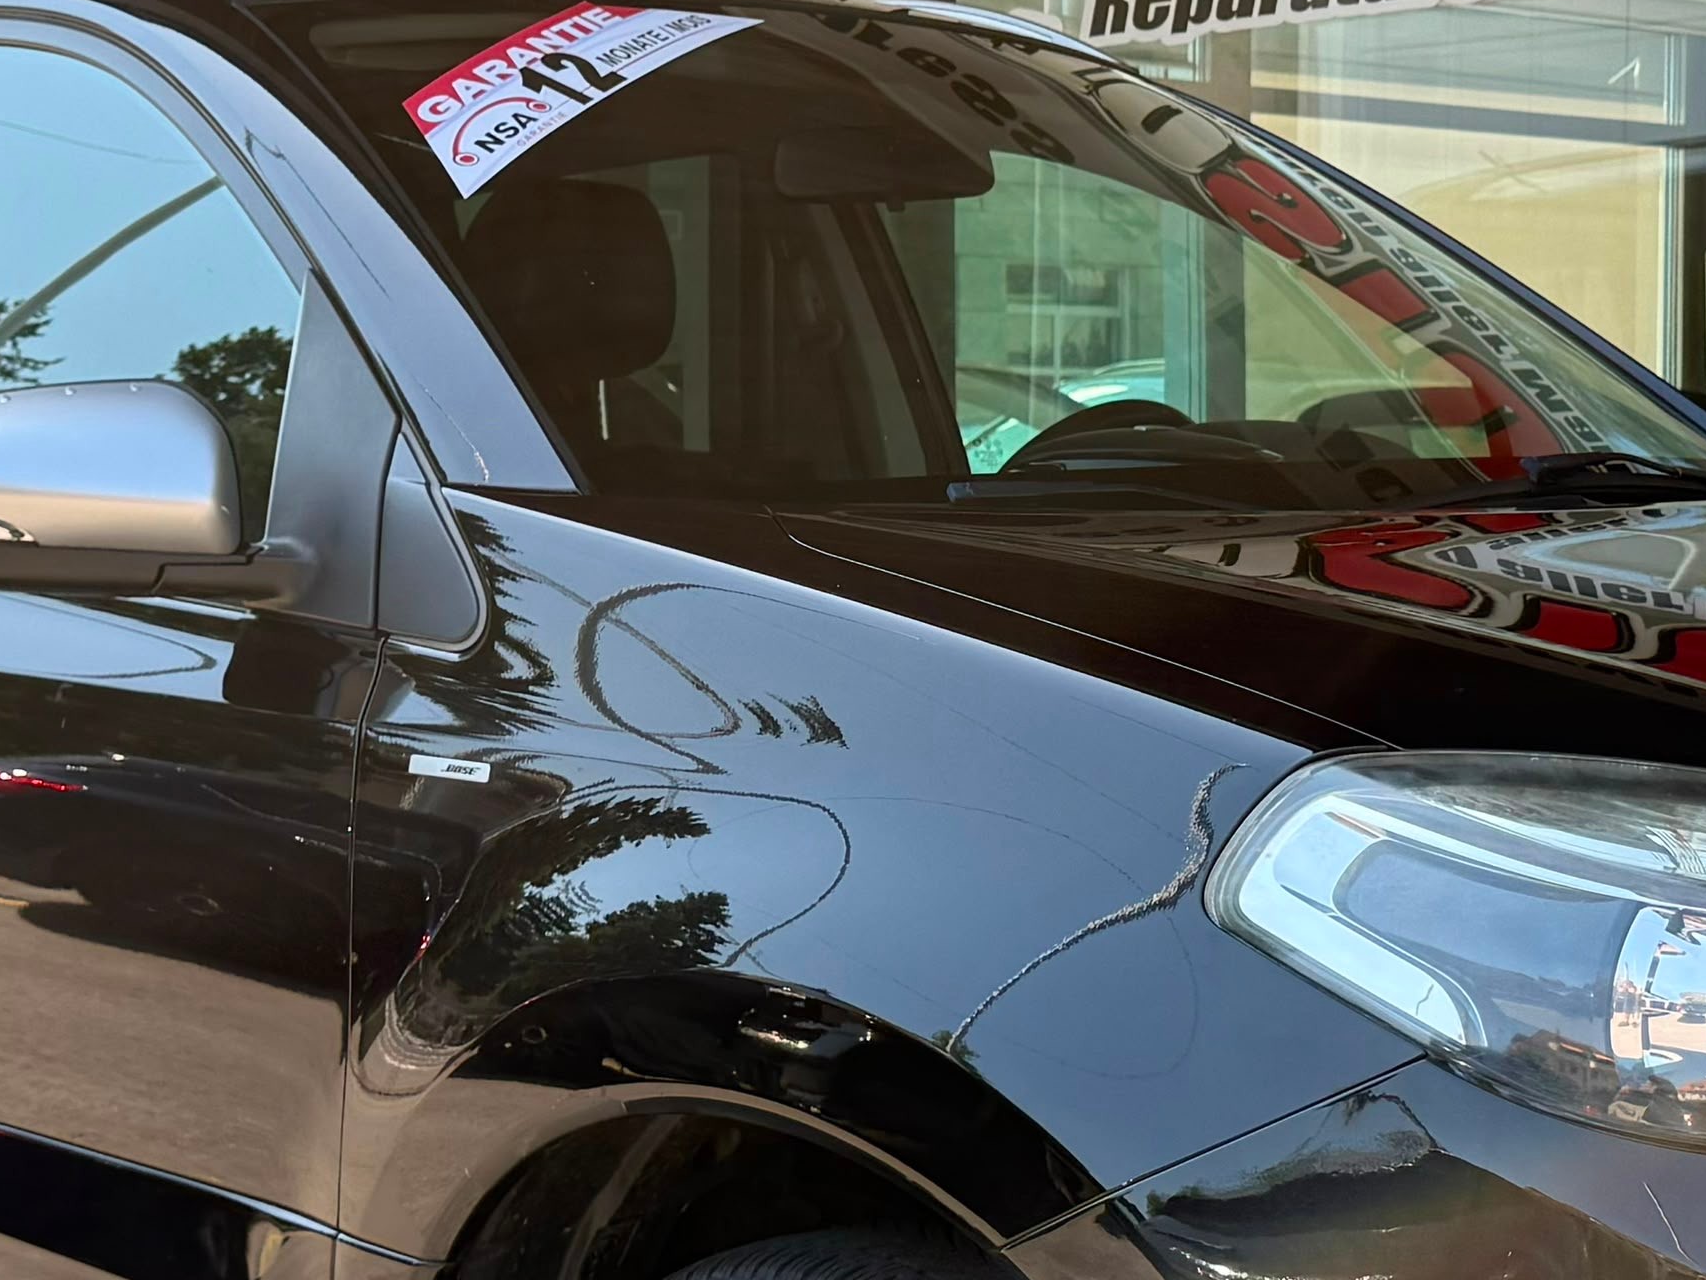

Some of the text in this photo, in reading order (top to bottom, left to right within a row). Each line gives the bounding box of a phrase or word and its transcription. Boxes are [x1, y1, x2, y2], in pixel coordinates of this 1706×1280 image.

[417, 6, 622, 124] GARANTIE
[519, 52, 628, 106] 12
[474, 112, 538, 154] NSA
